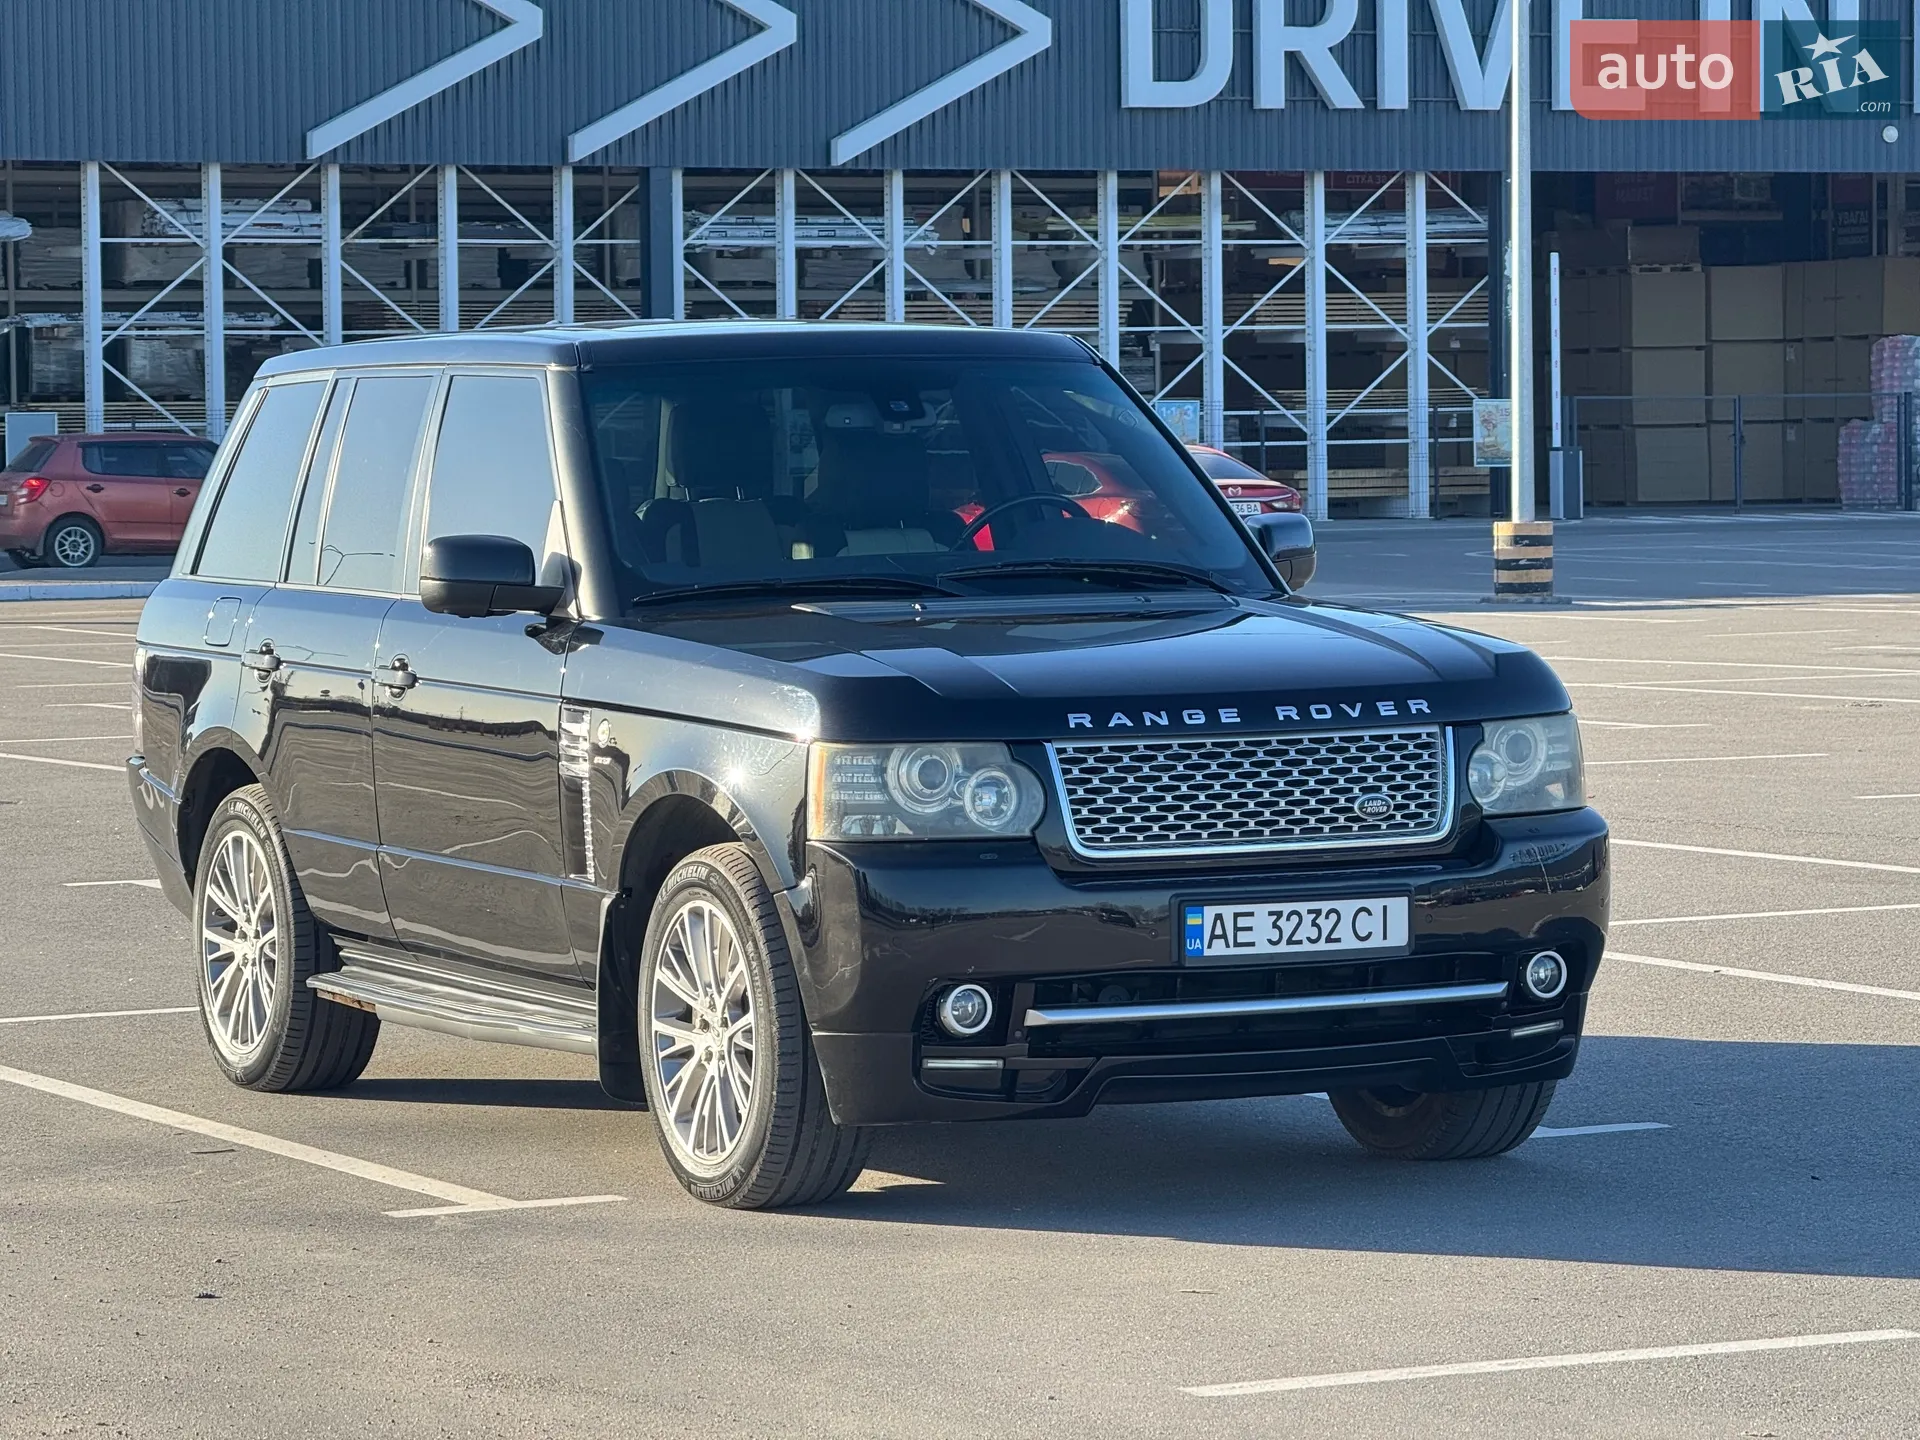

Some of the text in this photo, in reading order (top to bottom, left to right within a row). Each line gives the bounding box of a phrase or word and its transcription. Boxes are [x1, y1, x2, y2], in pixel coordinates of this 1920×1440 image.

[1121, 0, 1645, 110] DRIVE
[1699, 0, 1859, 112] IN
[1232, 503, 1260, 513] 36 BA
[1067, 699, 1431, 728] RANGE ROVER
[1364, 799, 1382, 807] LAND
[234, 801, 267, 839] MICHELIN
[666, 865, 709, 893] MICHELIN
[1206, 904, 1388, 949] AE 3232 CI
[1186, 938, 1202, 950] UA
[690, 1174, 736, 1199] MICHELIN
